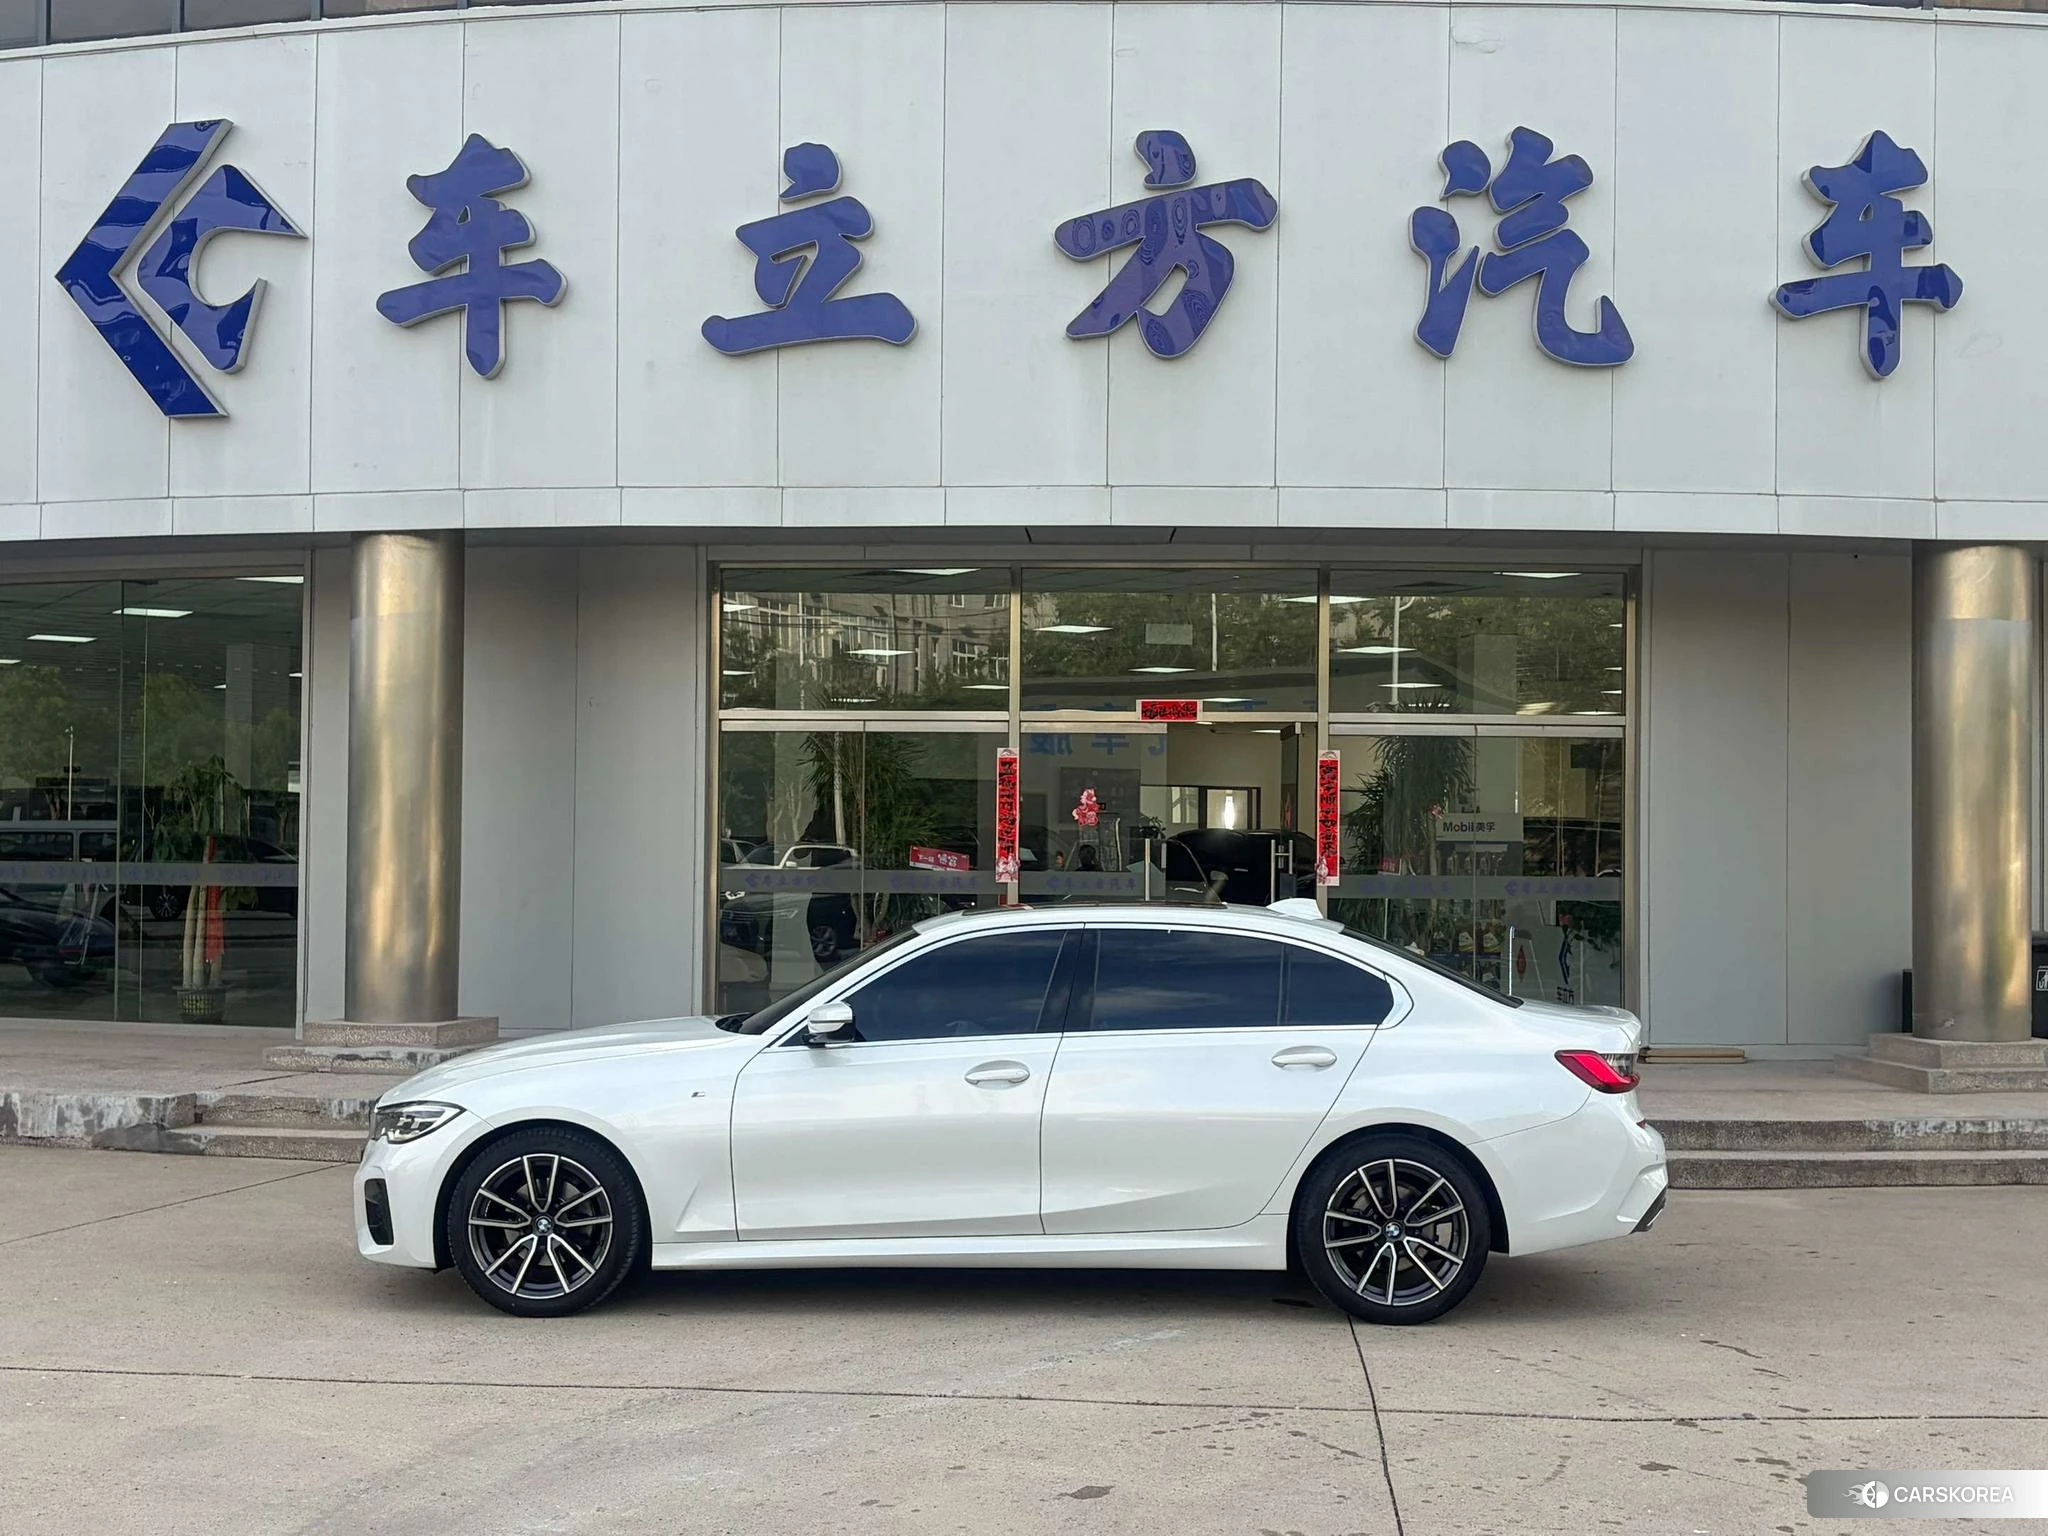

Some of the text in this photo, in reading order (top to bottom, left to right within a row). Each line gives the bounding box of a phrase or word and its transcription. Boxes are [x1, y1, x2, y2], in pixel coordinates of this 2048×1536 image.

[376, 126, 1963, 379] 车立方汽车
[1442, 821, 1474, 833] Mobil
